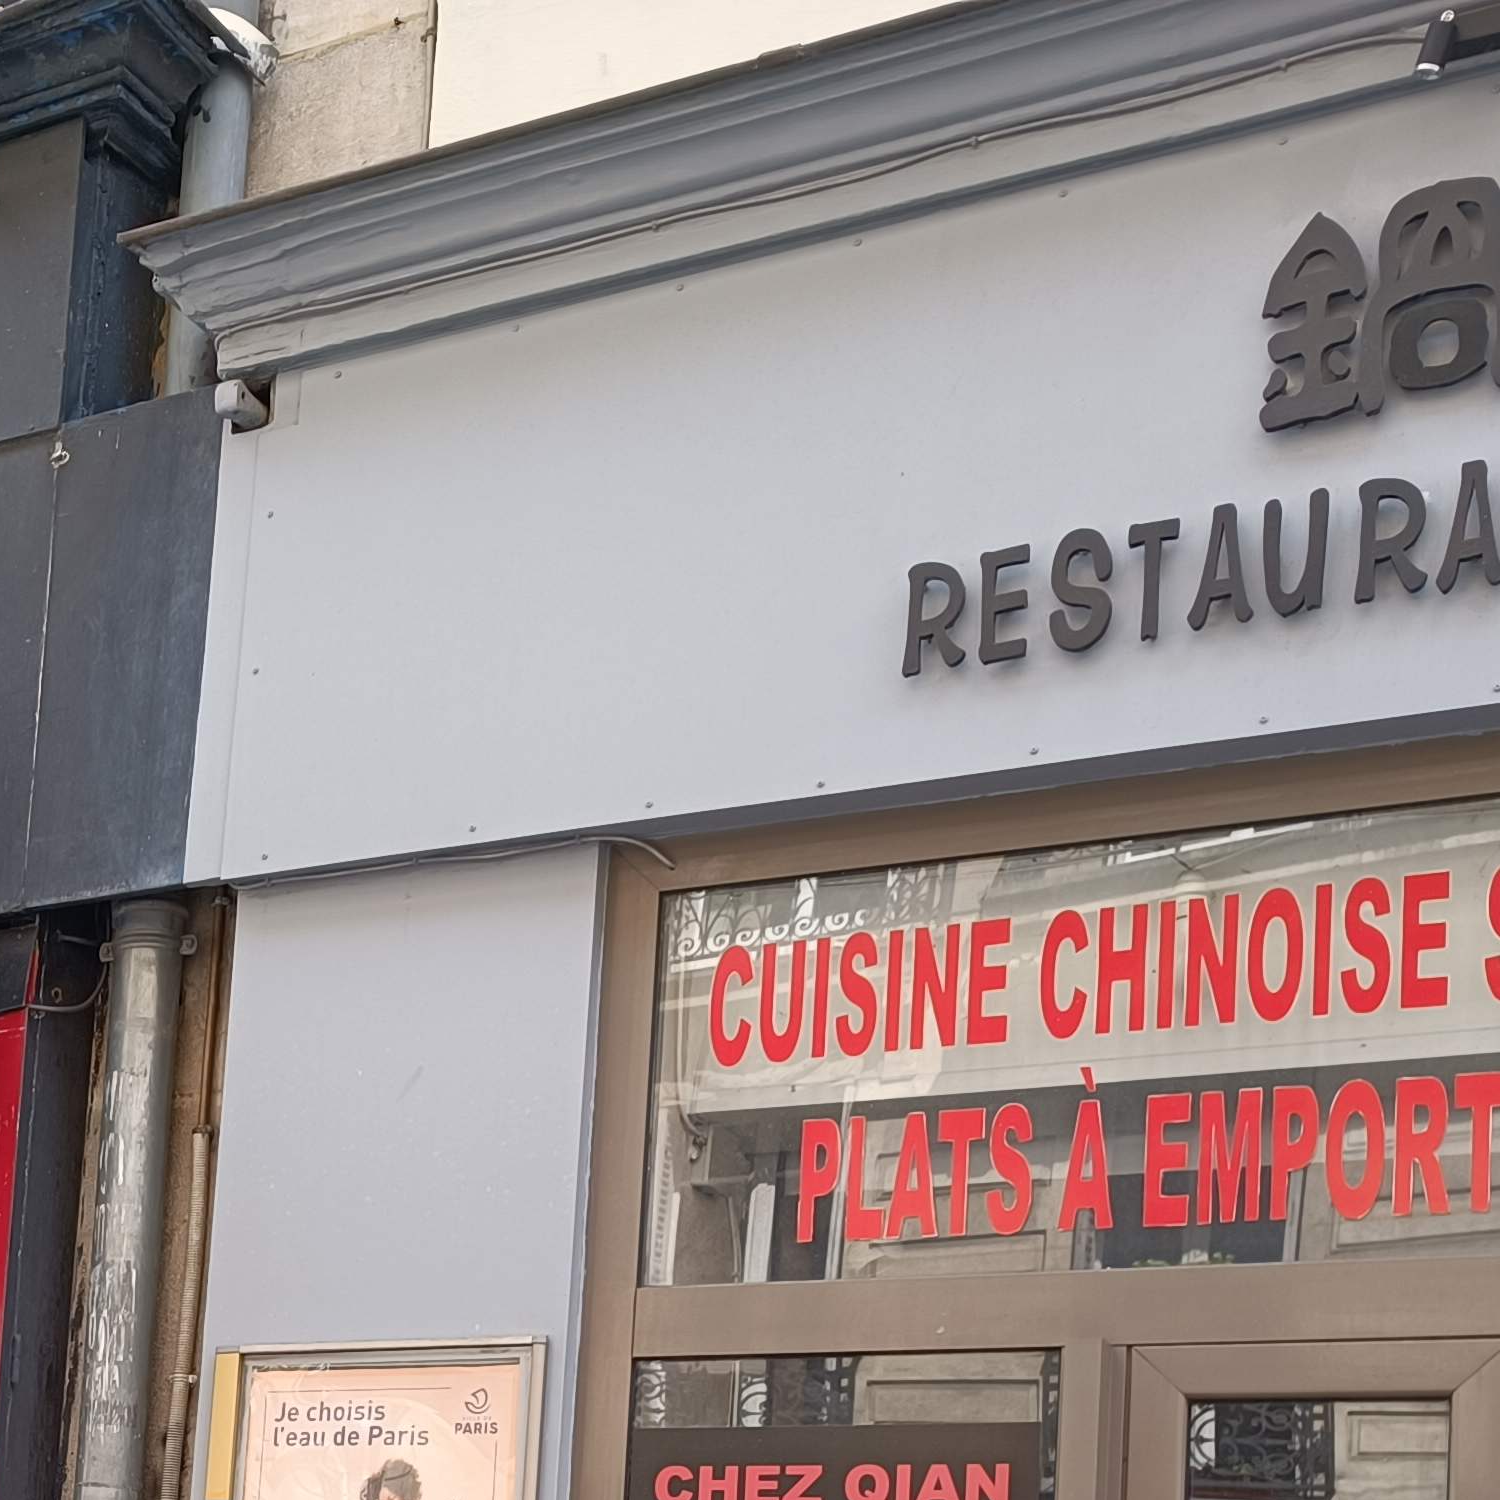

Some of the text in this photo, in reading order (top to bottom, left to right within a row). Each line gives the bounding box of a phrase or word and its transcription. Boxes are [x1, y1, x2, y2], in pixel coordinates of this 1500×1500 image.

[902, 458, 1500, 678] RESTAURA
[710, 916, 1012, 1067] CUISINE
[1040, 870, 1451, 1040] CHINOISE
[796, 1067, 1500, 1243] PLATS À EMPORT
[273, 1424, 429, 1447] l'eau de Paris
[274, 1399, 386, 1422] Je choisis
[454, 1422, 499, 1435] PARIS
